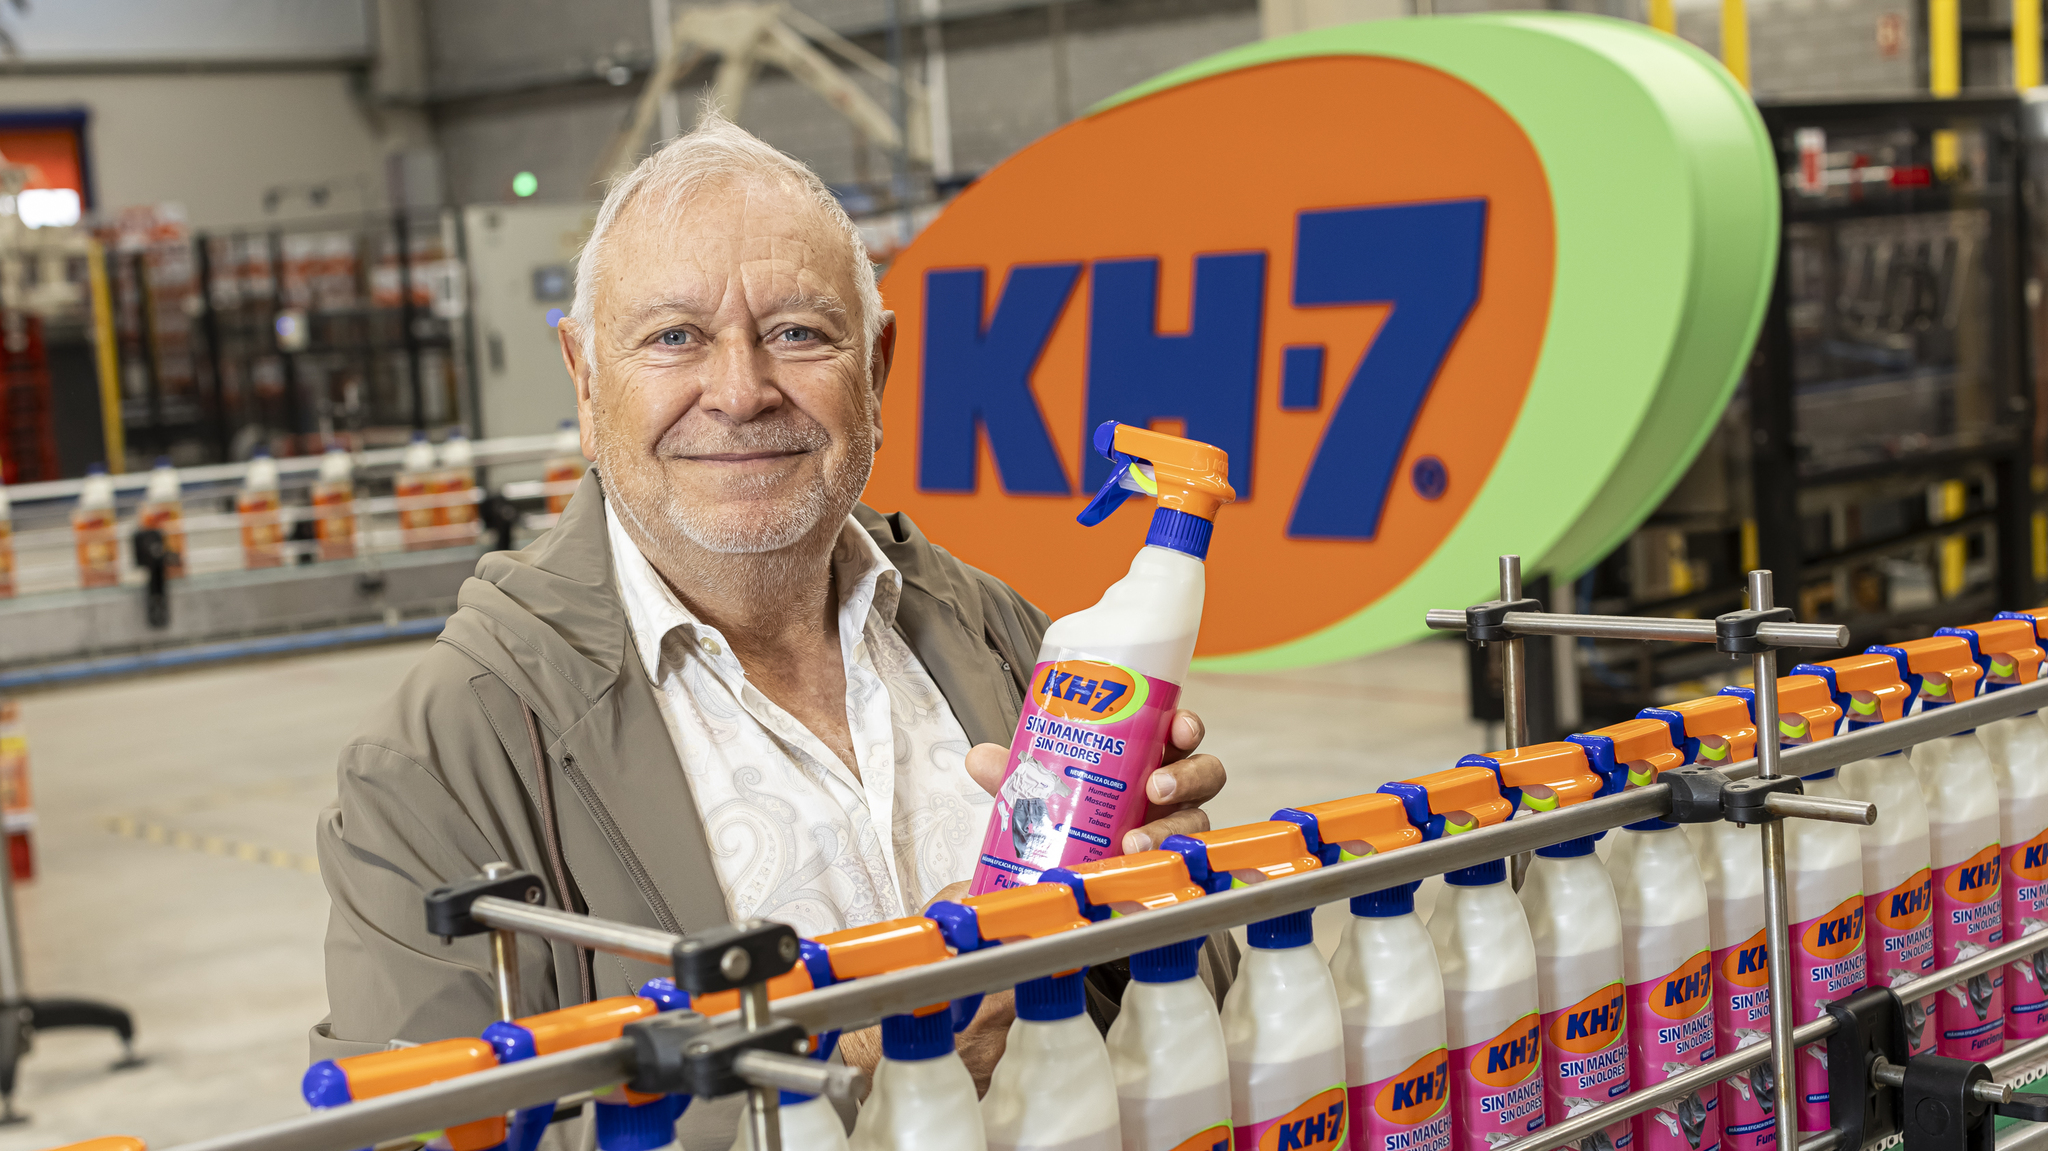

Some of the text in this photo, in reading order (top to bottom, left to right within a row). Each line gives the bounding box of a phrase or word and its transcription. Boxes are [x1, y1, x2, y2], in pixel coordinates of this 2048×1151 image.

[918, 198, 1488, 541] KH-7
[1041, 669, 1128, 713] KH-7
[1026, 716, 1125, 755] SIN MANCHAS
[1035, 737, 1101, 764] SIN OLORES
[1088, 787, 1120, 801] Humedad
[1103, 779, 1124, 790] OLORES
[1084, 796, 1116, 810] Mascotas
[1094, 809, 1114, 819] Sudor
[1088, 817, 1111, 829] Tabaco
[1081, 833, 1108, 845] MANCHAS
[1089, 847, 1103, 856] Vino
[2024, 843, 2048, 869] KH
[1958, 854, 2000, 891] KH-7
[1890, 878, 1931, 918] KH-7
[2019, 887, 2037, 901] SIN
[2033, 899, 2045, 911] SIN
[1953, 899, 2002, 924] SIN MANCH
[1817, 906, 1863, 947] KH-7
[1885, 925, 1933, 952] SIN MANCH
[1968, 922, 1980, 934] SIN
[1737, 944, 1768, 975] KH
[1901, 949, 1912, 961] SIN
[1664, 962, 1710, 1007] KH-7
[1812, 966, 1833, 982] SIN
[1828, 968, 1865, 992] SIN OLORES
[1732, 994, 1753, 1010] SIN
[1749, 1008, 1762, 1020] SIN
[1566, 994, 1623, 1040] KH-7
[1659, 1026, 1680, 1043] SIN
[1676, 1040, 1689, 1053] SIN
[1690, 1028, 1713, 1048] OLORES
[1487, 1025, 1539, 1074] KH-7
[1560, 1044, 1628, 1077] SIN MANCHA
[1392, 1061, 1447, 1111] KH-7
[1579, 1063, 1625, 1089] SIN OLORES
[1482, 1094, 1505, 1113] SIN
[1500, 1096, 1542, 1123] SIN OLORES
[1278, 1100, 1344, 1151] KH-7
[1386, 1133, 1410, 1151] SIN
[1422, 1134, 1449, 1151] OLORES
